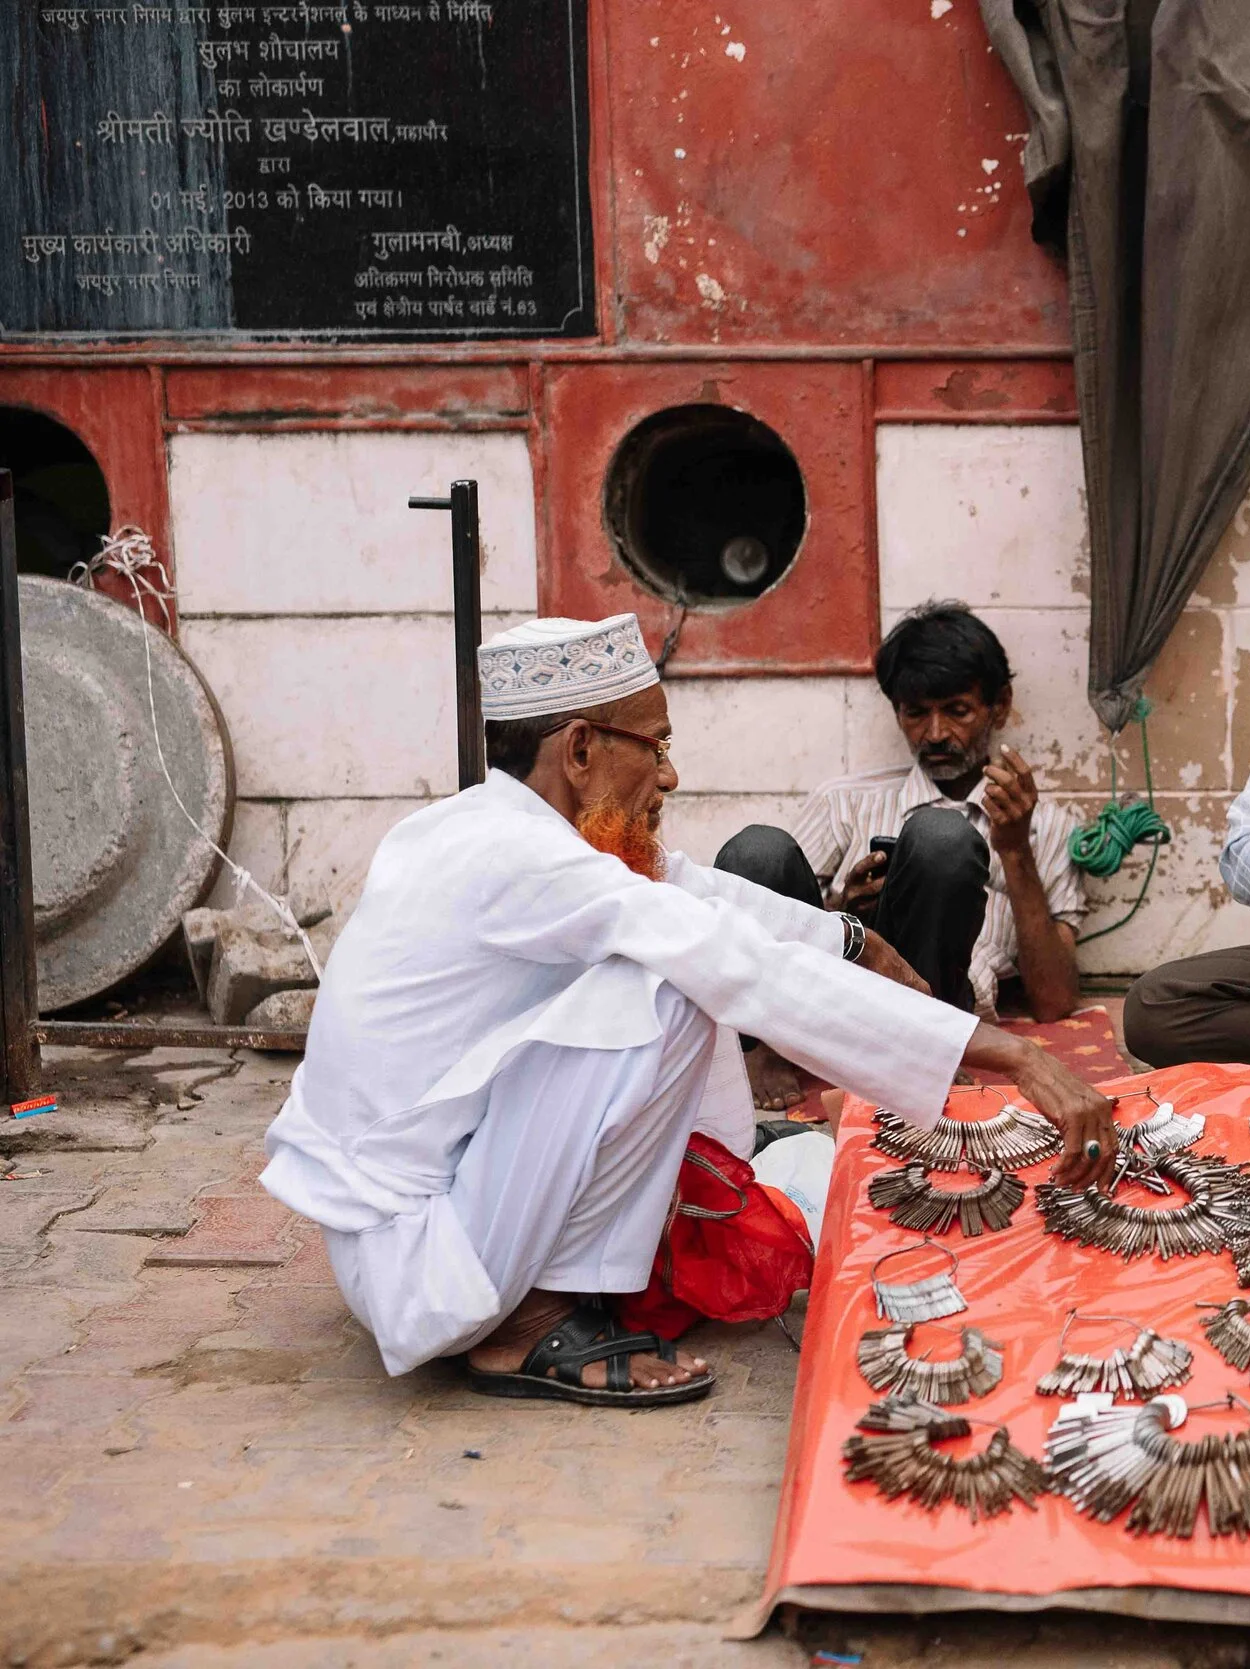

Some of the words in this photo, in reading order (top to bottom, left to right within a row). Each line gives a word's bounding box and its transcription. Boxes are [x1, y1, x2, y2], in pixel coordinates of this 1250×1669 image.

[41, 8, 88, 29] जयपुर
[94, 8, 127, 24] नगर
[133, 4, 171, 24] निगम
[176, 8, 210, 24] द्वारा
[217, 7, 255, 29] सुलभ
[353, 2, 368, 22] के
[374, 6, 421, 22] माध्यम
[428, 1, 441, 22] से
[199, 41, 250, 69] सुलभ
[259, 32, 339, 60] शौचालय
[217, 80, 241, 97] का
[249, 72, 324, 97] लोकार्पण
[97, 111, 172, 144] श्रीमती
[180, 109, 251, 143] ज्योति
[257, 157, 291, 173] द्वारा
[151, 191, 171, 210] 01
[223, 190, 269, 210] 2013
[275, 182, 300, 209] को
[307, 182, 352, 210] किया
[22, 235, 66, 263] मुख्य
[72, 227, 159, 256] कार्यकारी
[165, 225, 252, 255] अधिकारी
[76, 274, 121, 296] जयपुर
[127, 274, 161, 289] नगर
[163, 268, 201, 289] निगम
[353, 265, 424, 288] अतिक्रमण
[427, 264, 485, 288] निरोधक
[488, 264, 534, 288] समिति
[383, 295, 423, 318] क्षेत्रीय
[427, 294, 464, 318] पार्षद
